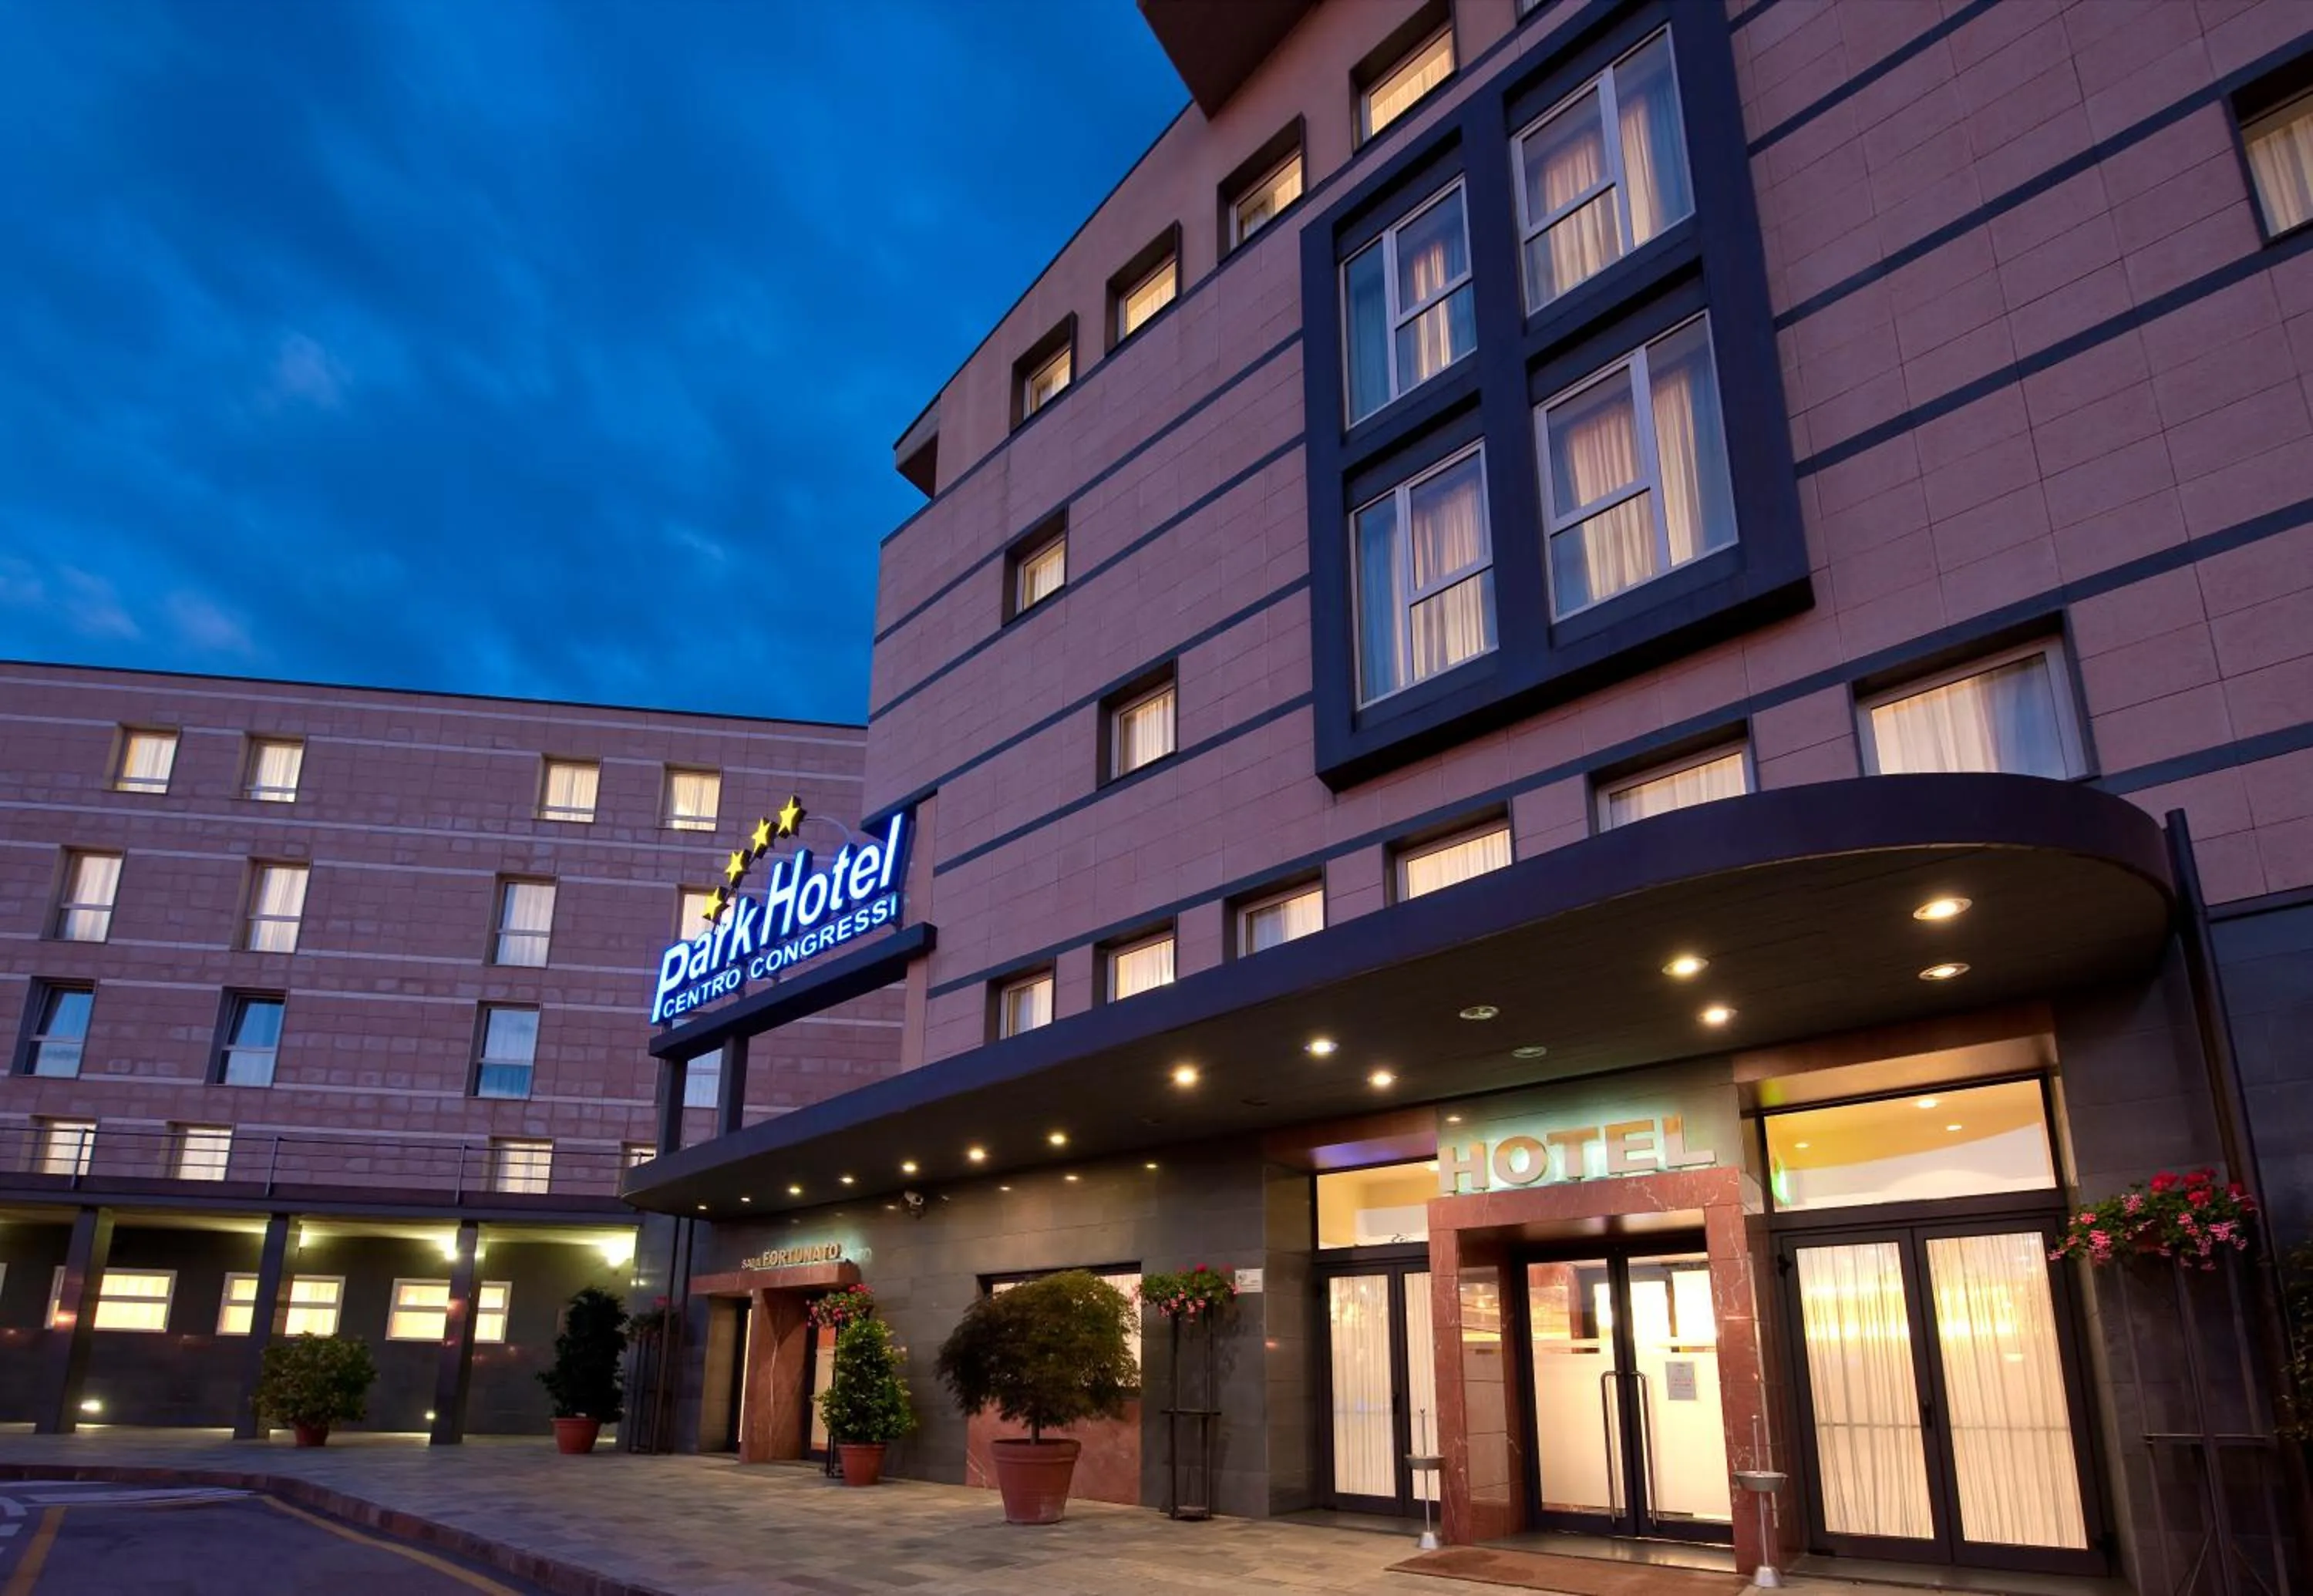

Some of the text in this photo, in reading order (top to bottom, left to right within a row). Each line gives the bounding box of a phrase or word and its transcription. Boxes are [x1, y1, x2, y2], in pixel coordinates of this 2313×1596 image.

[662, 897, 897, 1019] CENTRO CONGRESSI
[1439, 1113, 1716, 1192] HOTEL
[763, 1243, 839, 1267] FORTUNATO
